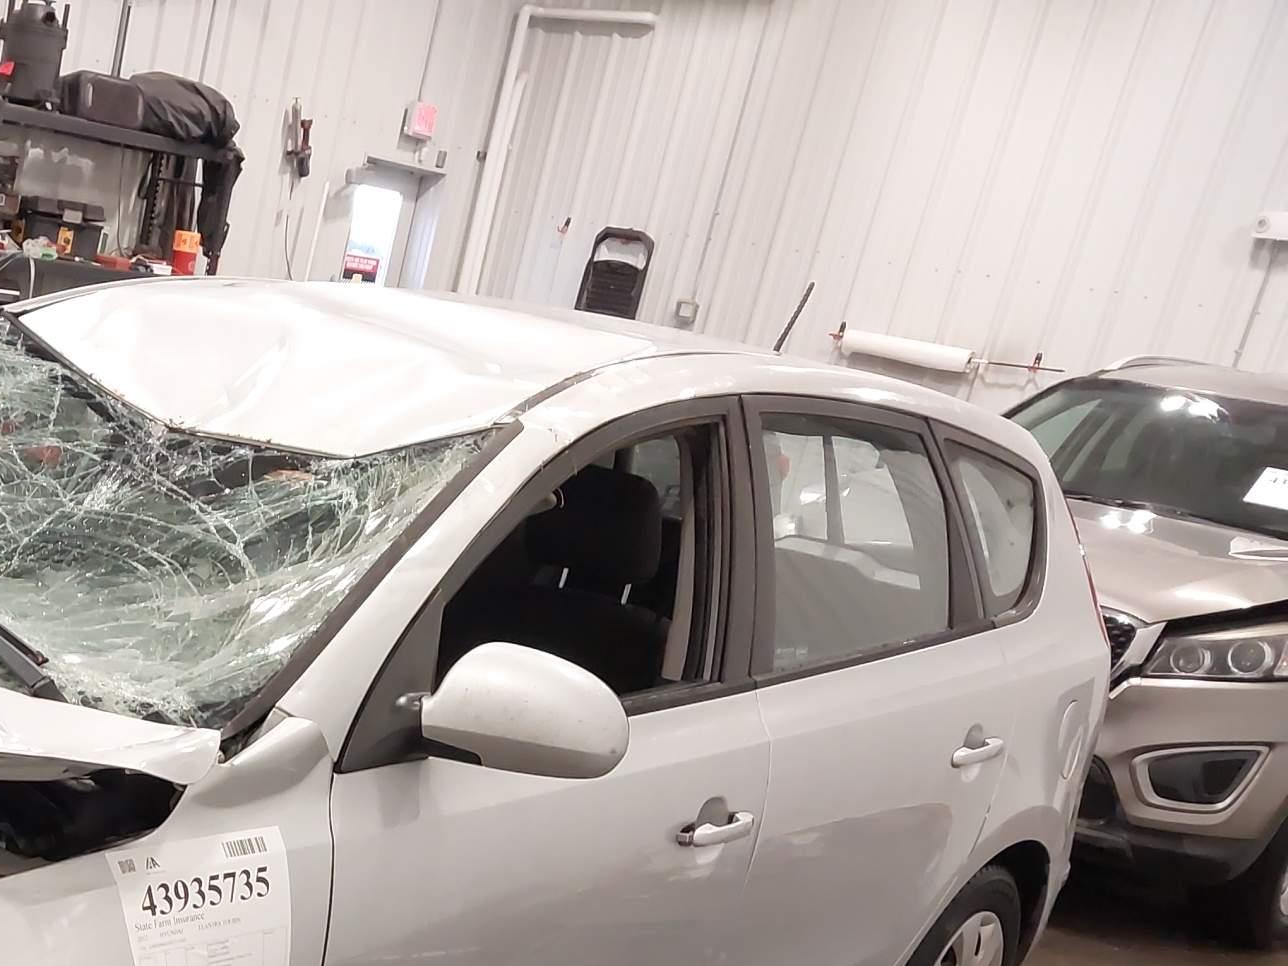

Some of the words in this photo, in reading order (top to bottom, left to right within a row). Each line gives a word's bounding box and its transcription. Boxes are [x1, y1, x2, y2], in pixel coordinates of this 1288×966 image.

[142, 866, 270, 917] 43935735
[134, 921, 153, 932] State
[154, 917, 172, 929] Farm
[173, 912, 206, 926] Insurance
